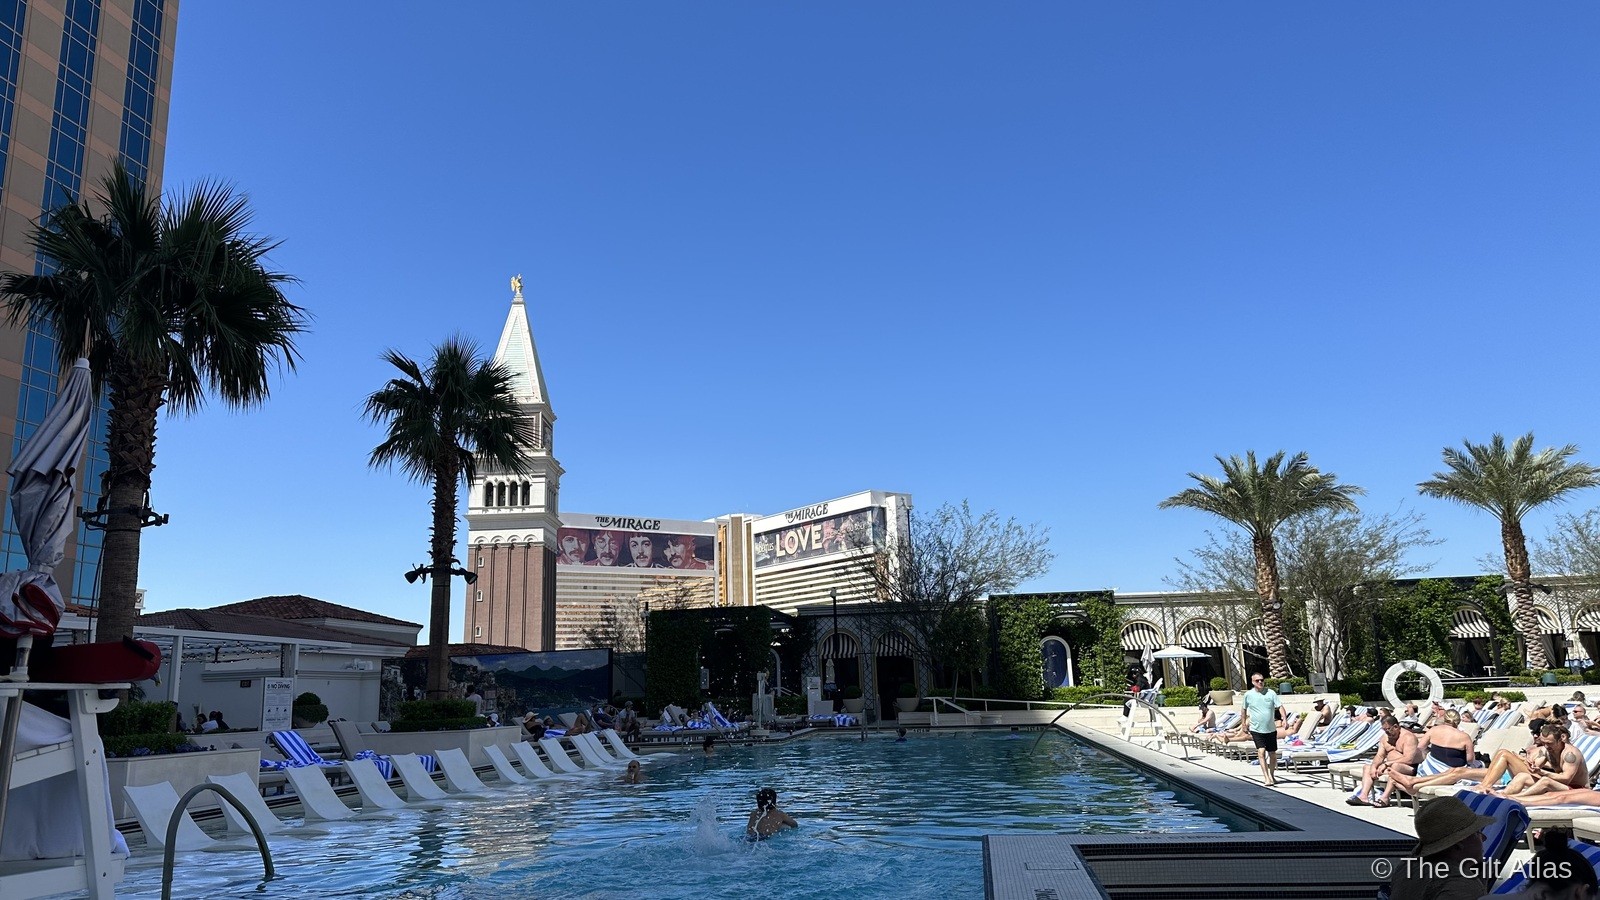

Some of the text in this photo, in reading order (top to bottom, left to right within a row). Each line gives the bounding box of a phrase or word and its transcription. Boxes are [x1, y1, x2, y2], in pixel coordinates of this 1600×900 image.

[788, 503, 828, 523] MIRAGE
[600, 517, 661, 530] MIRAGE
[776, 524, 823, 557] LOVE
